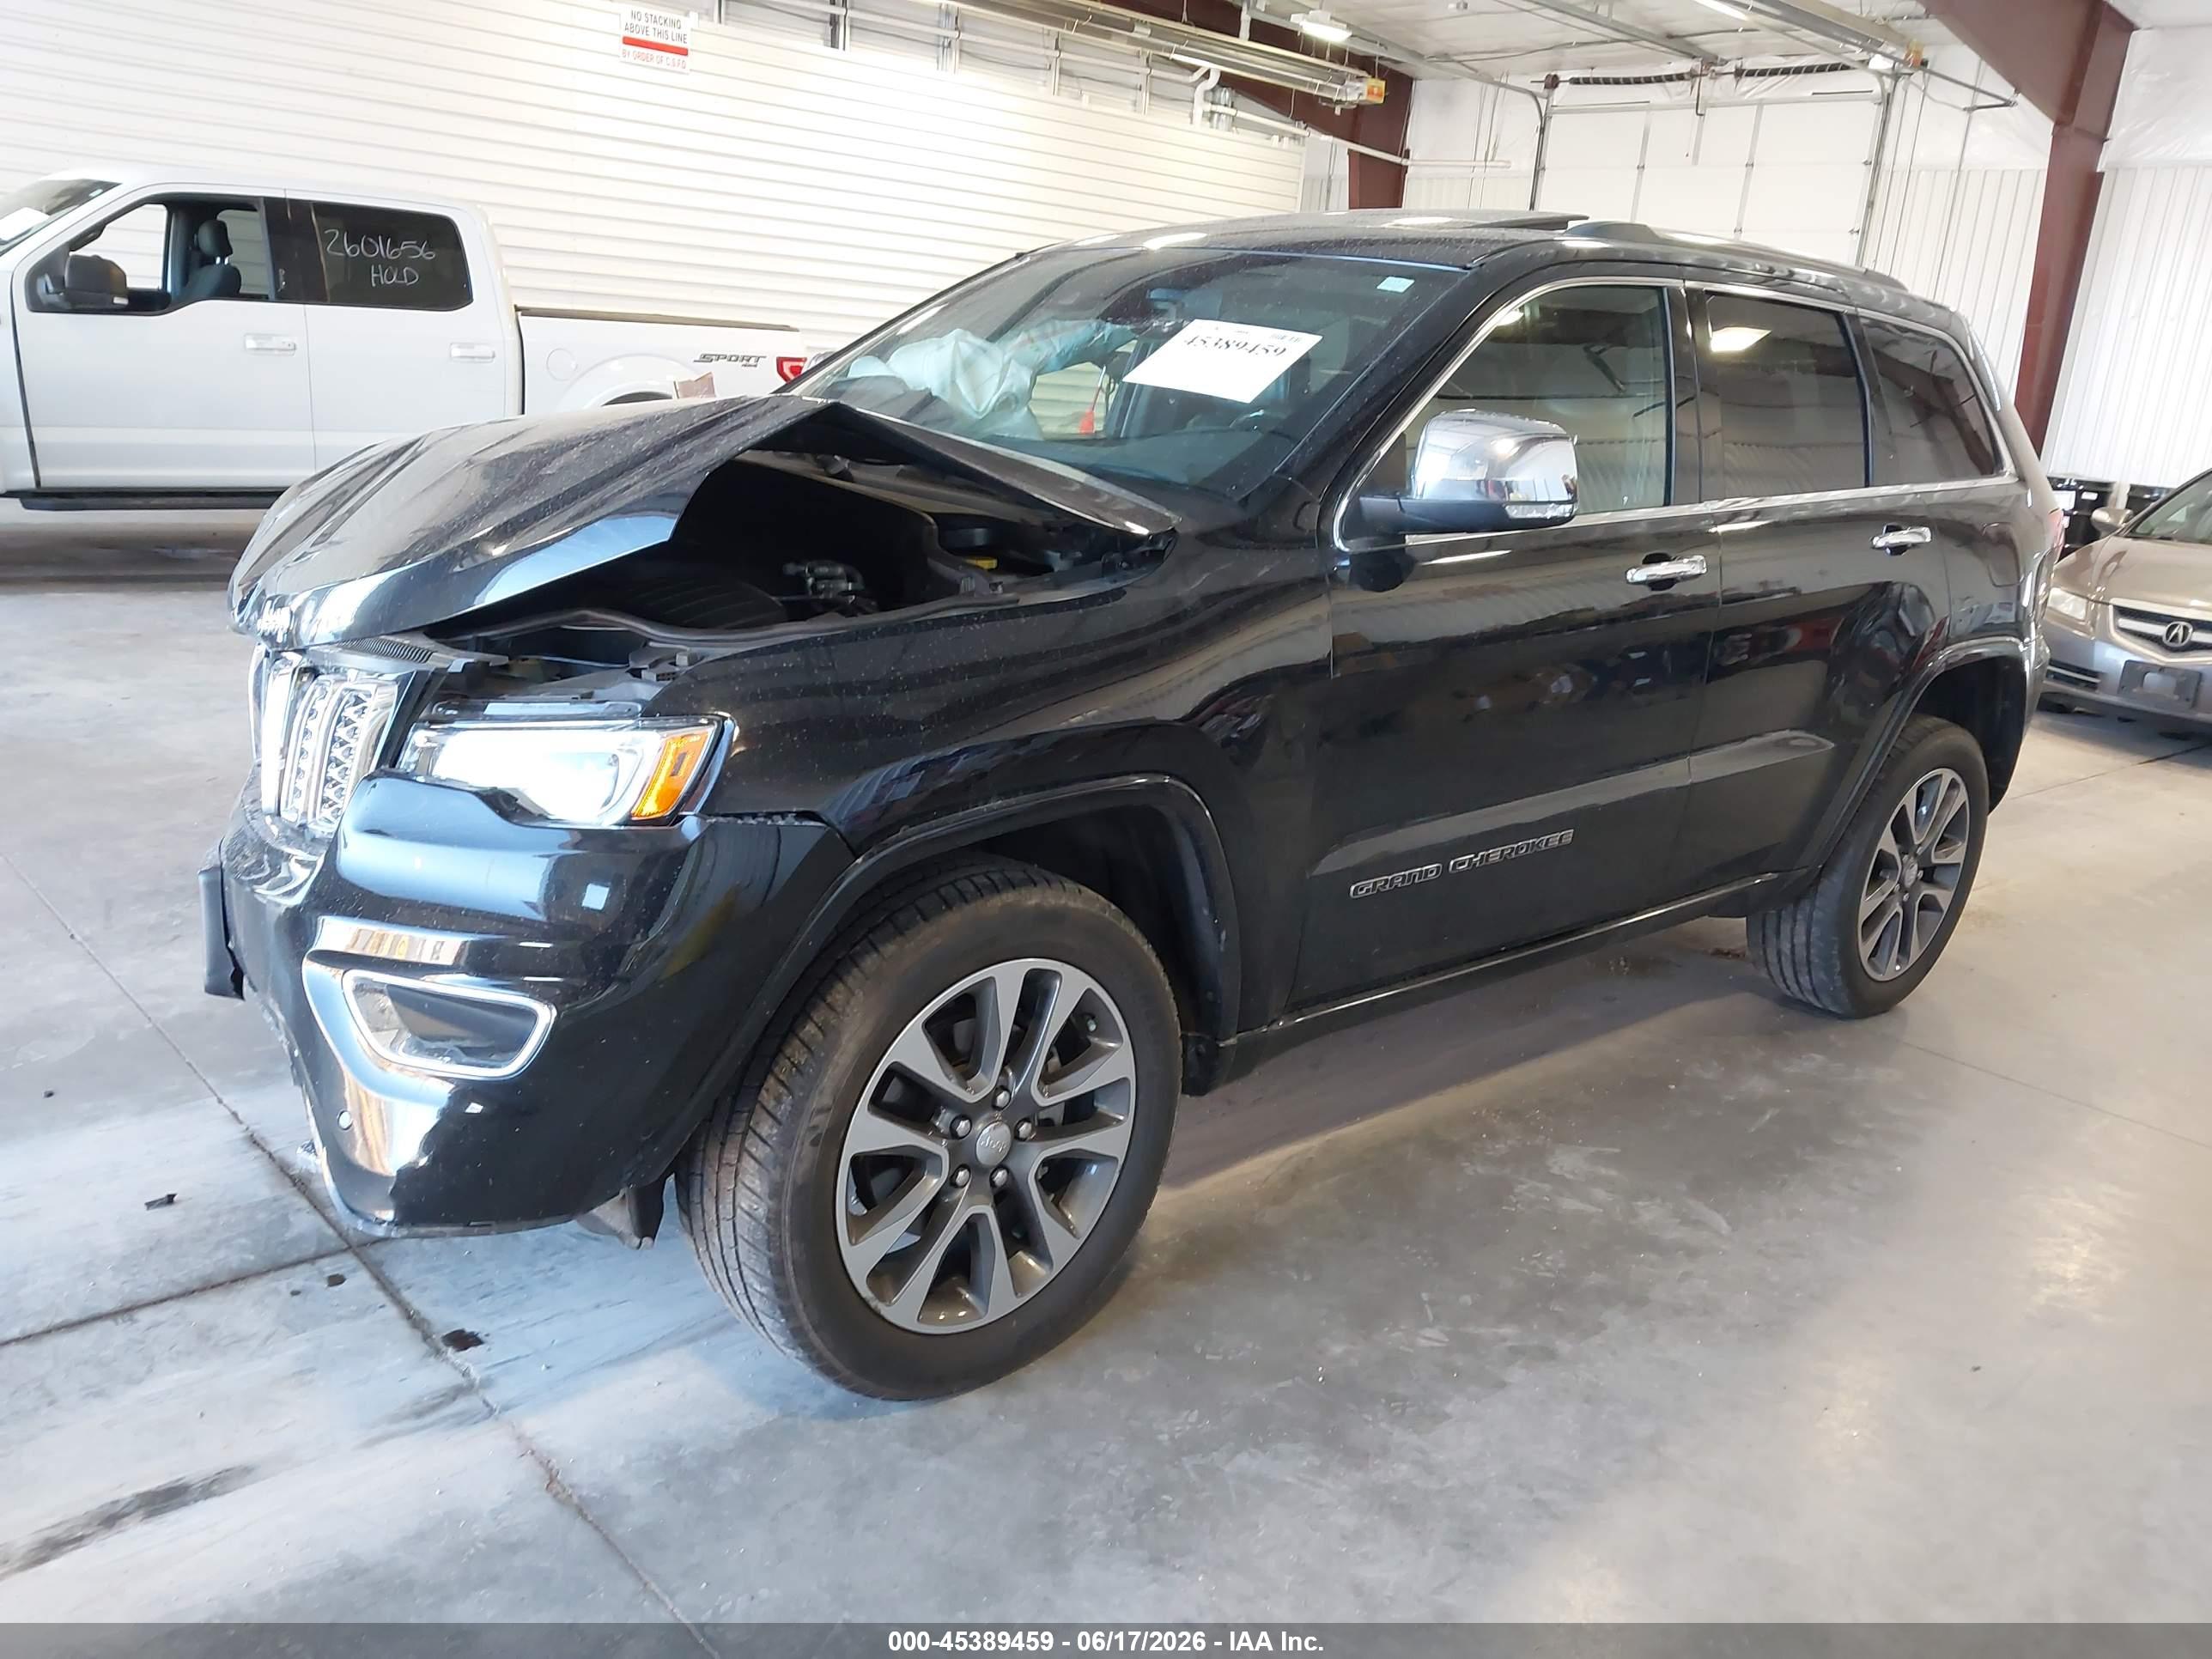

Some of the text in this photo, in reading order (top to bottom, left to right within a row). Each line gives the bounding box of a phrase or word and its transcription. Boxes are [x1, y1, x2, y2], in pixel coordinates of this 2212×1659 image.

[631, 9, 682, 30] NO STACKING
[624, 22, 688, 44] ABOVE THIS LINE
[324, 228, 436, 259] 2601656
[370, 264, 420, 287] HOLD
[1184, 335, 1287, 356] 45389459
[694, 353, 768, 363] SPORT
[1349, 829, 1575, 899] GRAND CHEROKEE
